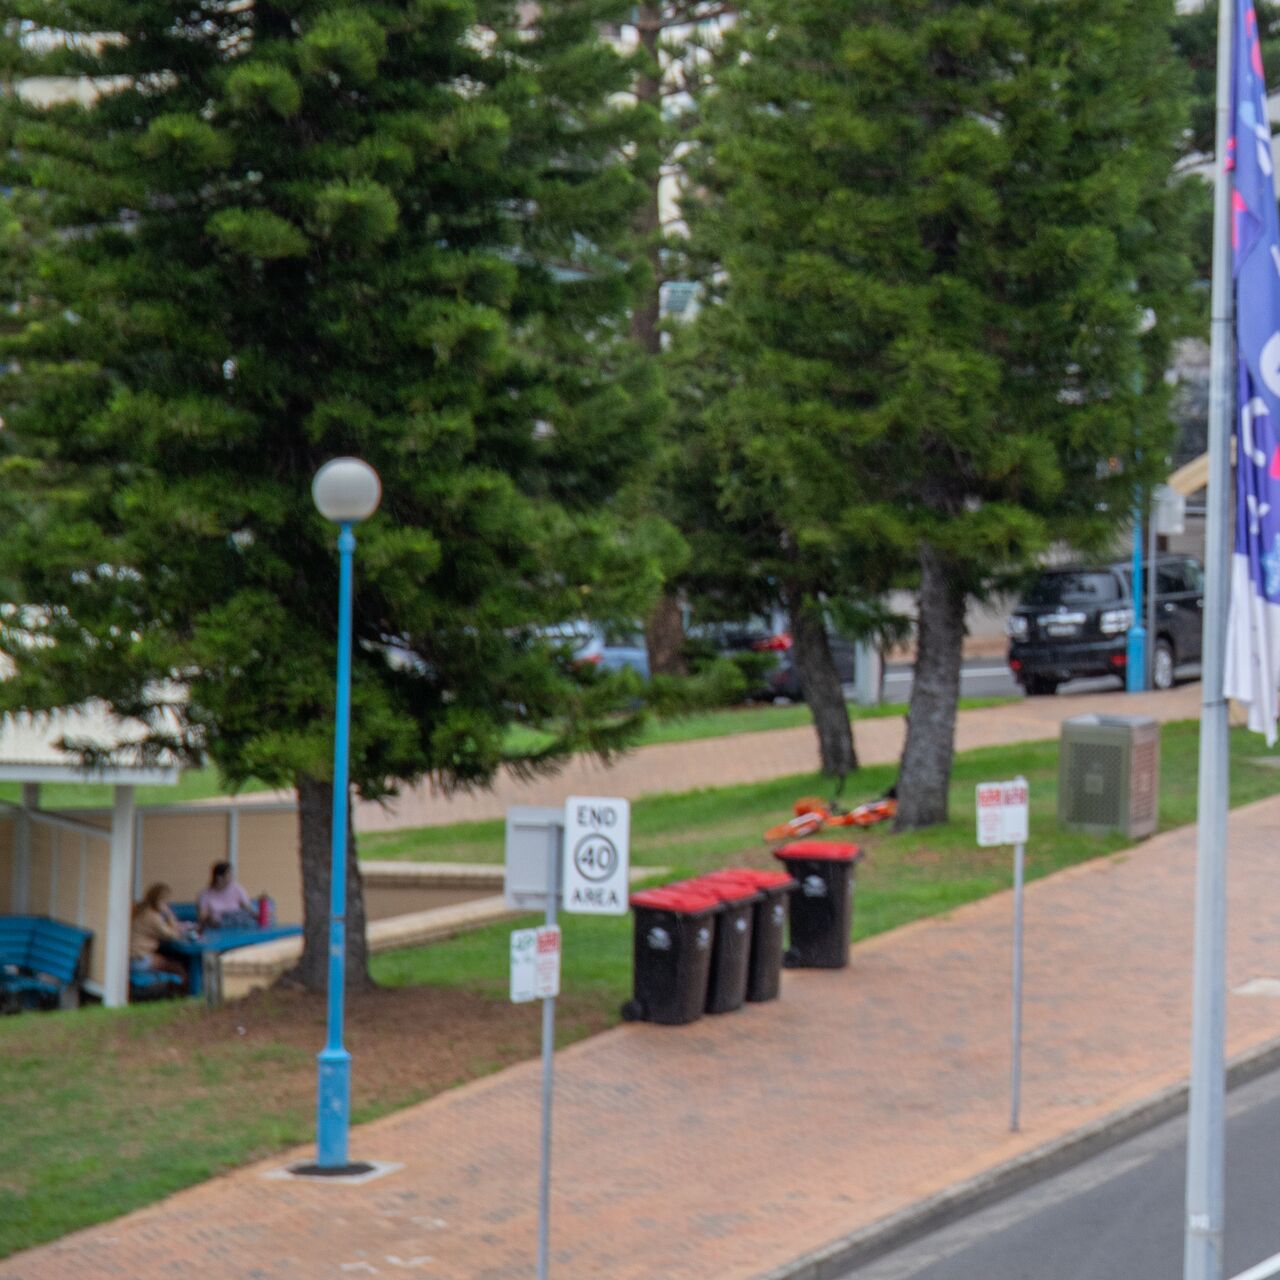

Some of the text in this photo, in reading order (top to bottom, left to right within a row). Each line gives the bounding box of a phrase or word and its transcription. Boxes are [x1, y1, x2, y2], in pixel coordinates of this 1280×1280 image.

[576, 805, 618, 827] END
[579, 846, 612, 869] 40
[573, 887, 619, 906] AREA
